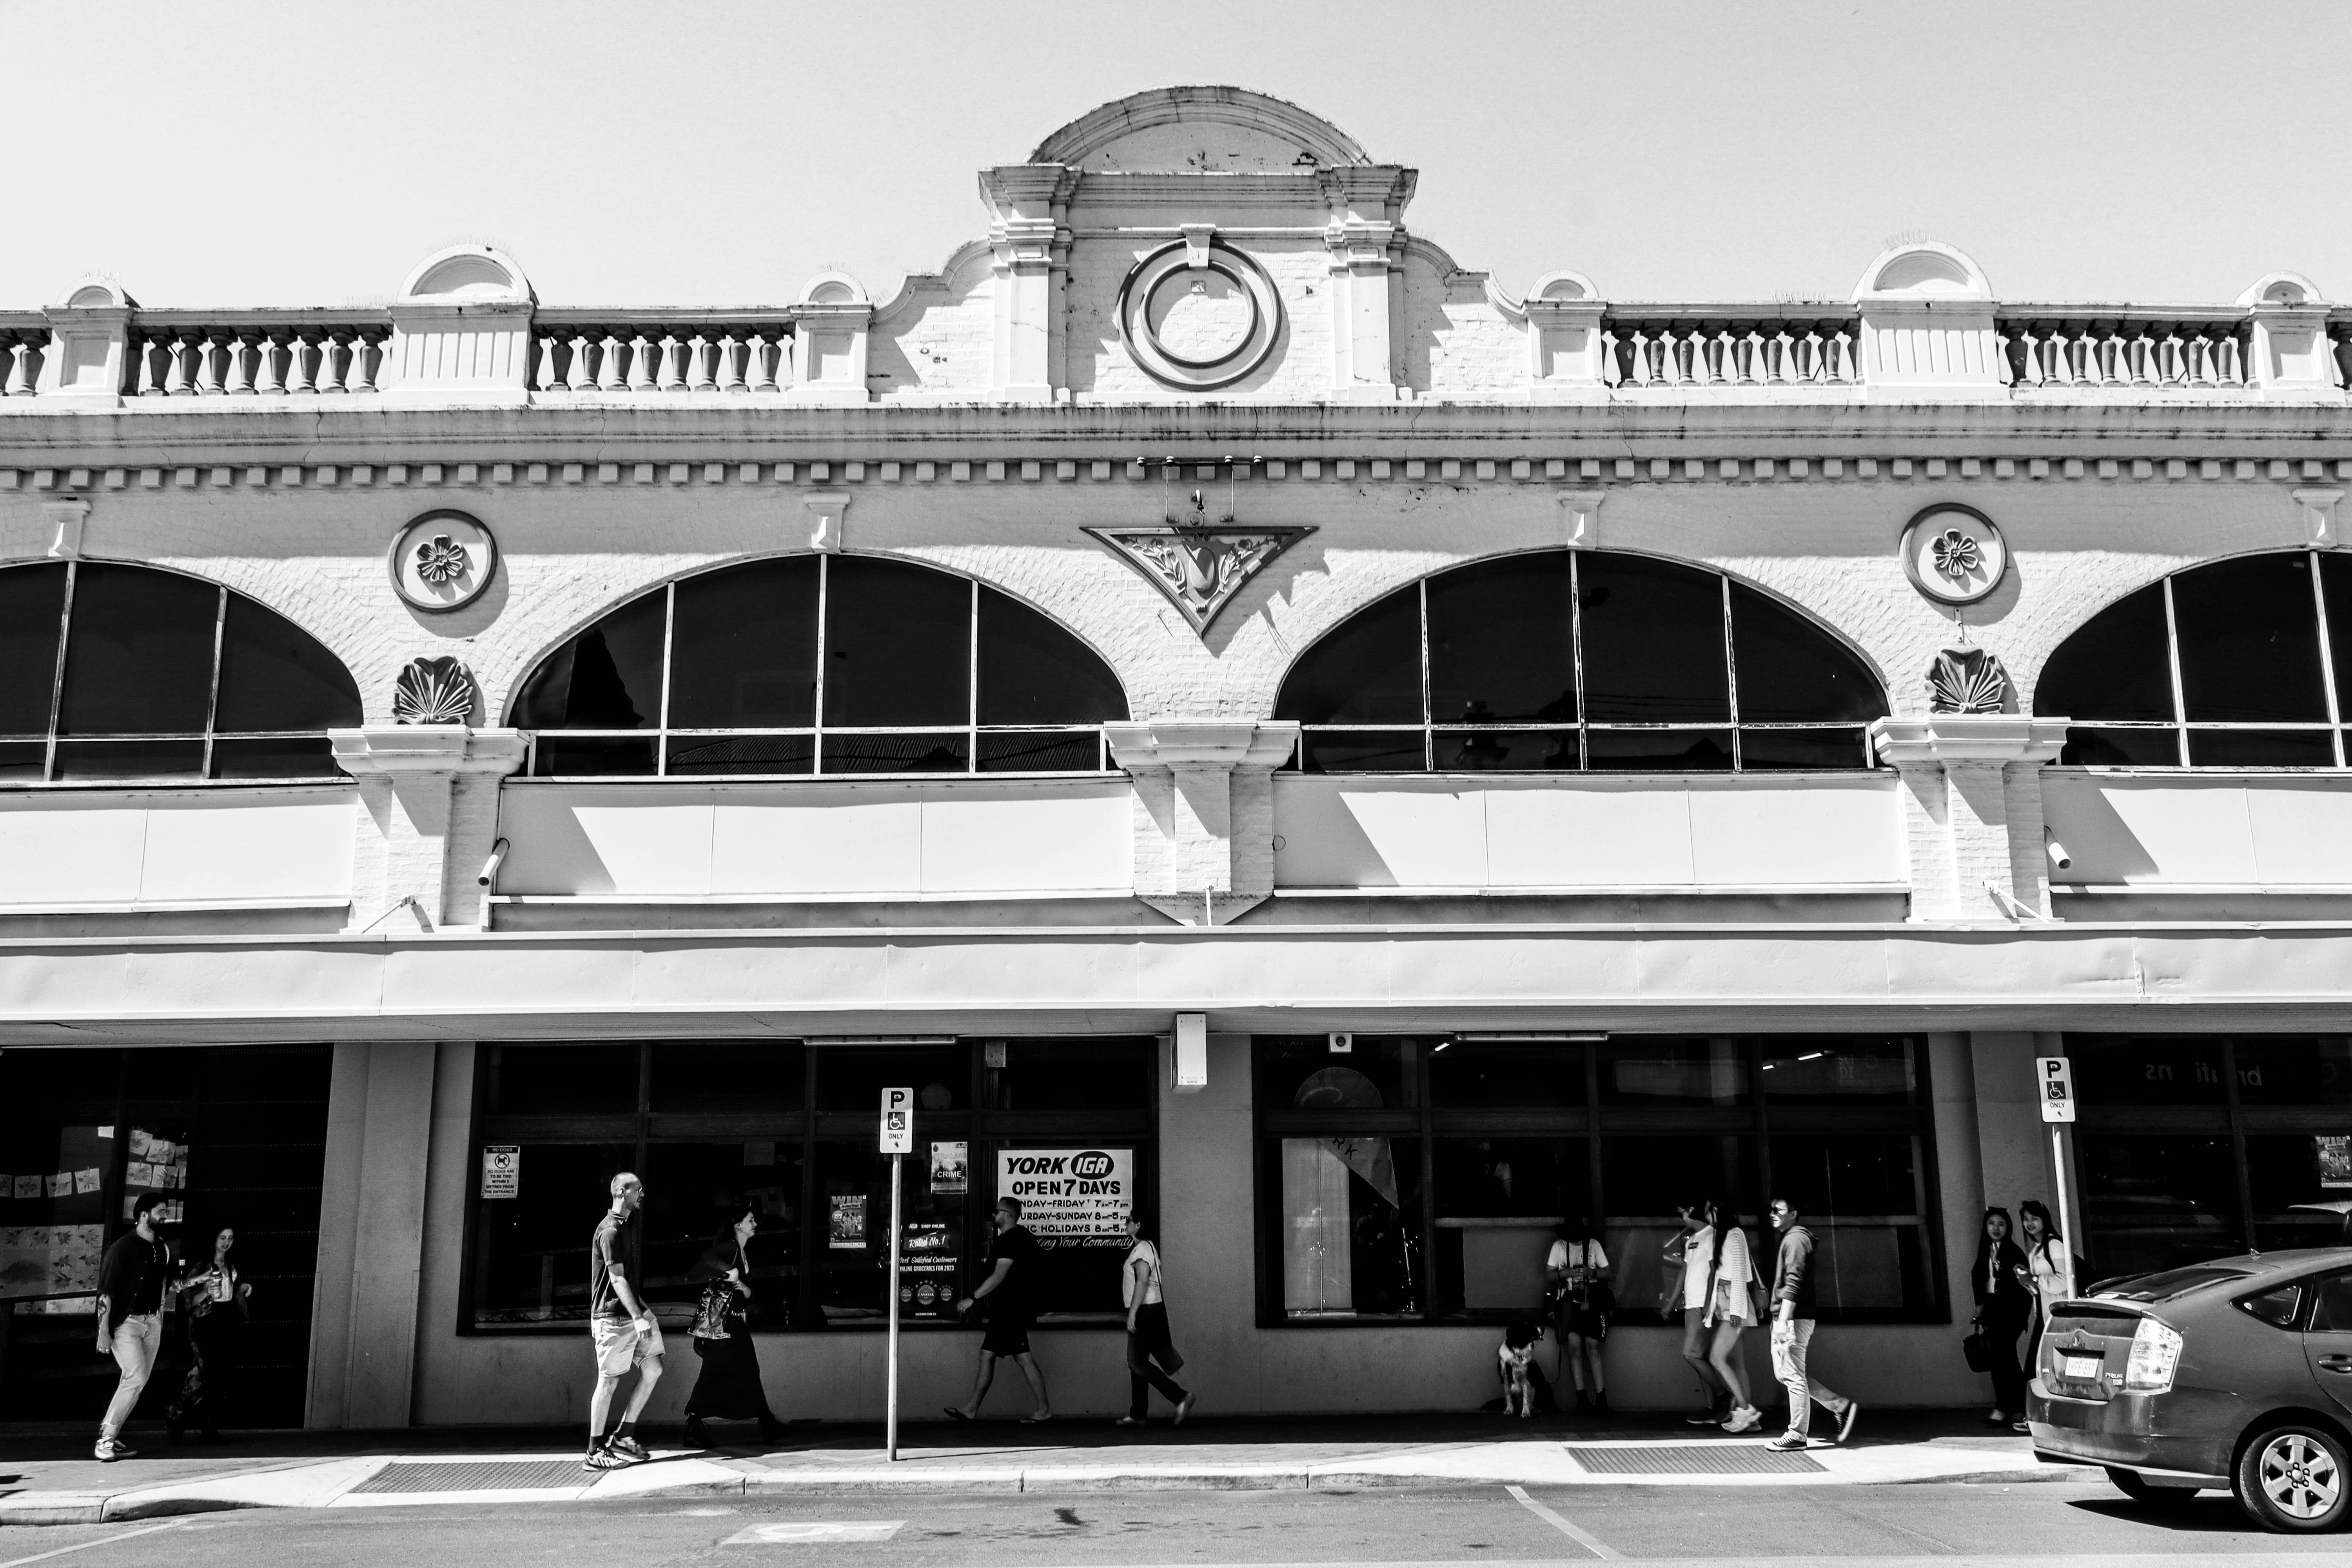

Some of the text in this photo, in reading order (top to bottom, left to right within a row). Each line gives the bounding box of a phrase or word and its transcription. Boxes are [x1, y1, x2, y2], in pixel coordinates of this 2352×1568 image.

[2046, 1061, 2062, 1078] P
[890, 1091, 905, 1109] P
[2316, 1136, 2347, 1145] WIN
[1332, 1138, 1358, 1160] RK
[1007, 1157, 1109, 1174] YORK IGA
[1012, 1179, 1121, 1196] OPEN 7 DAYS
[831, 1196, 862, 1205] WIN
[1020, 1200, 1085, 1208] NDAY-FRIDAY
[1020, 1212, 1093, 1220] URDAY-SUNDAY
[1041, 1225, 1091, 1233] HOLIDAYS
[909, 1237, 928, 1248] Rated
[1059, 1236, 1080, 1247] Your
[1083, 1236, 1134, 1249] Community
[911, 1256, 932, 1264] Satisfied
